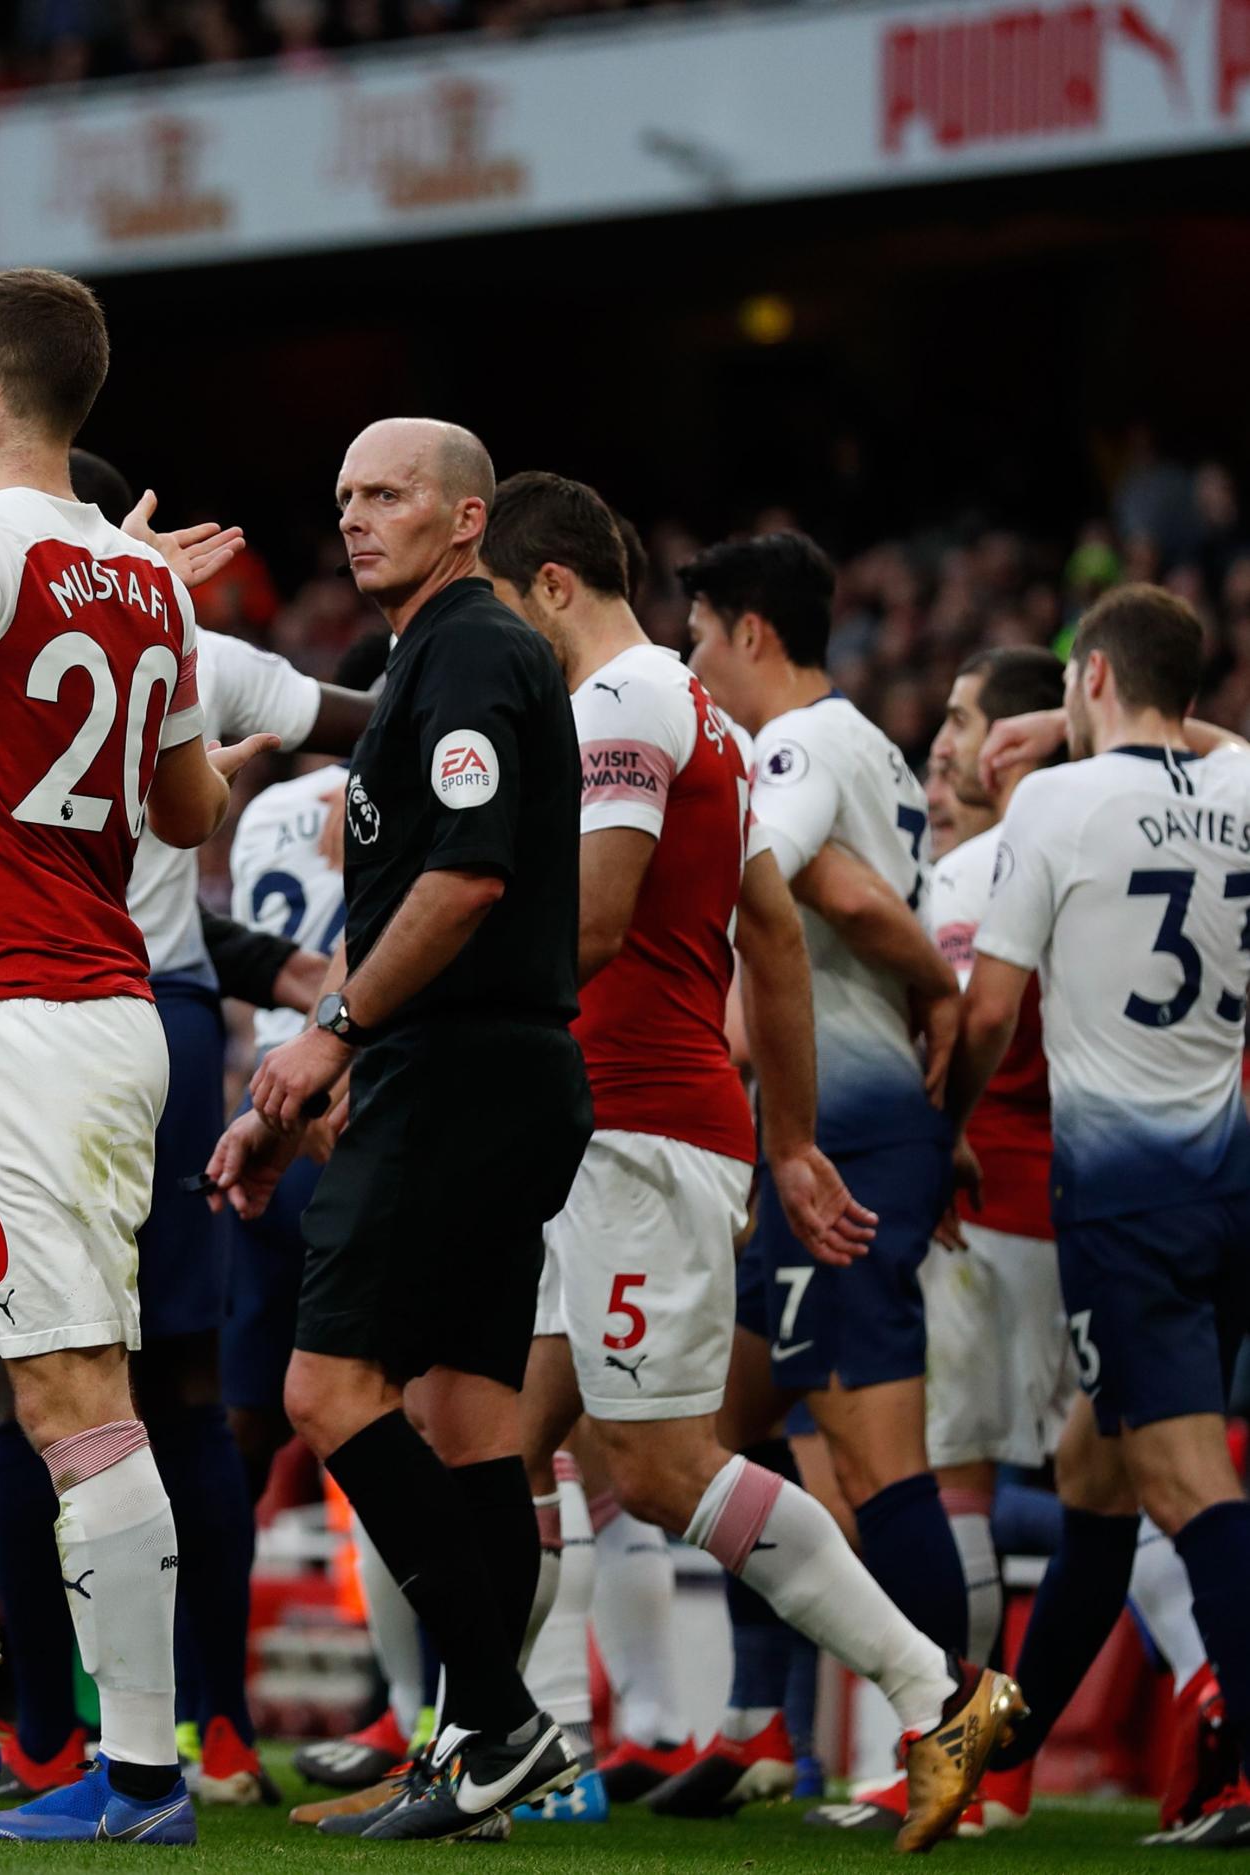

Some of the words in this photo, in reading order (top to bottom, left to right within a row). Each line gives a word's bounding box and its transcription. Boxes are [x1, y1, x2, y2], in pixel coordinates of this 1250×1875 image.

[49, 560, 169, 633] MUSTAFI
[12, 631, 178, 839] 20
[441, 747, 488, 779] EA
[441, 773, 490, 792] SPORTS
[581, 769, 658, 792] WANDA
[588, 751, 640, 768] VISIT
[1138, 807, 1250, 853] DAVIES
[602, 1273, 647, 1350] 5
[774, 1265, 816, 1341] 7
